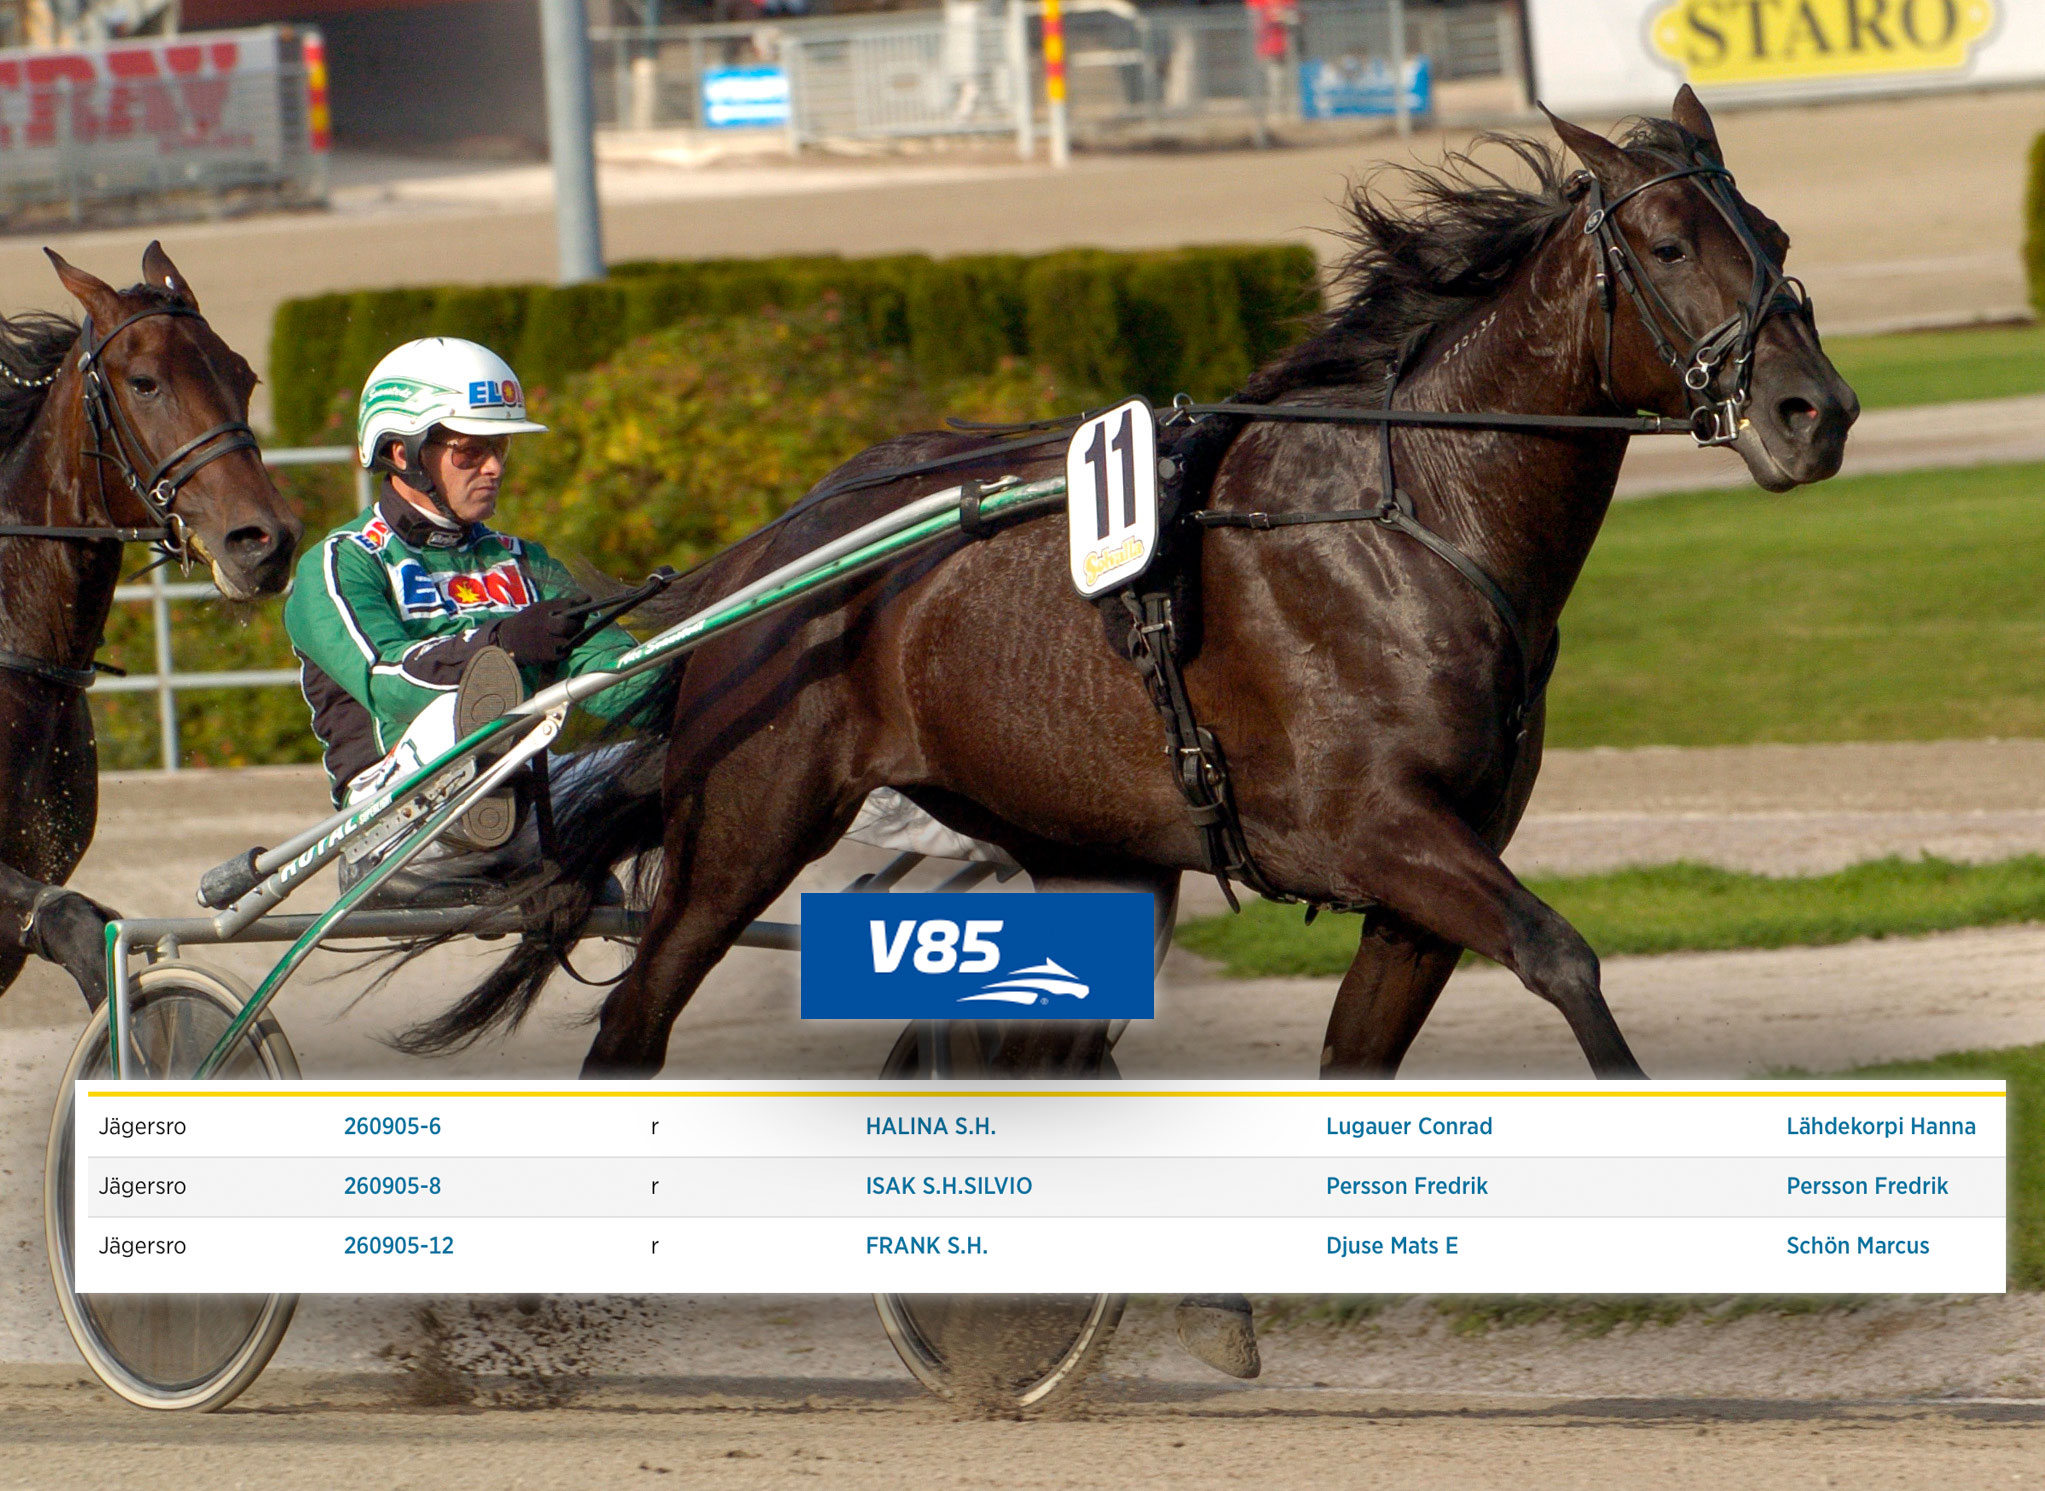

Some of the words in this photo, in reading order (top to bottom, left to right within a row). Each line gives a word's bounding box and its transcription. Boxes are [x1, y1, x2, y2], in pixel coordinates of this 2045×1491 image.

[1684, 0, 1958, 64] STARO
[1084, 408, 1136, 541] 11
[400, 564, 531, 615] EON
